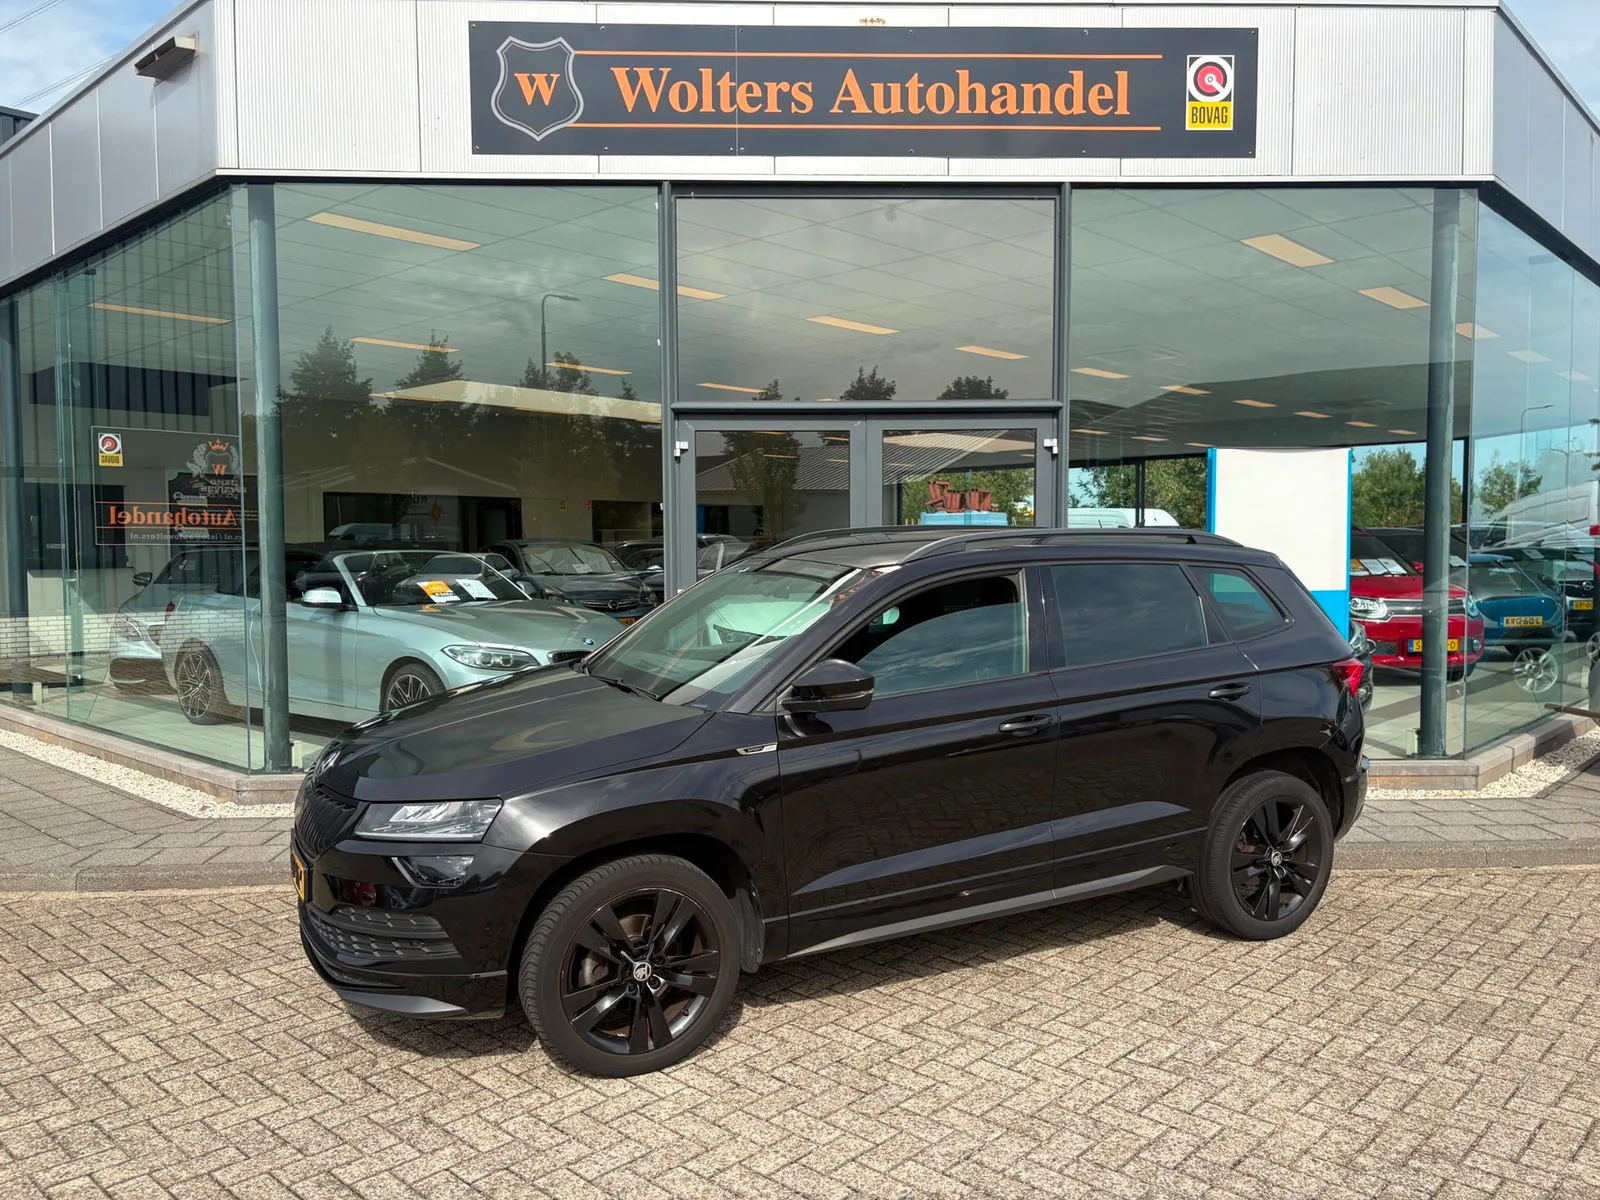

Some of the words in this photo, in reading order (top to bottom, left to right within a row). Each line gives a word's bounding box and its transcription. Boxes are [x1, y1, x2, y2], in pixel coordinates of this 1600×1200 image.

[514, 72, 559, 107] W
[611, 66, 814, 115] Wolters
[829, 68, 1131, 117] Autohandel
[1191, 106, 1228, 124] BOVAG
